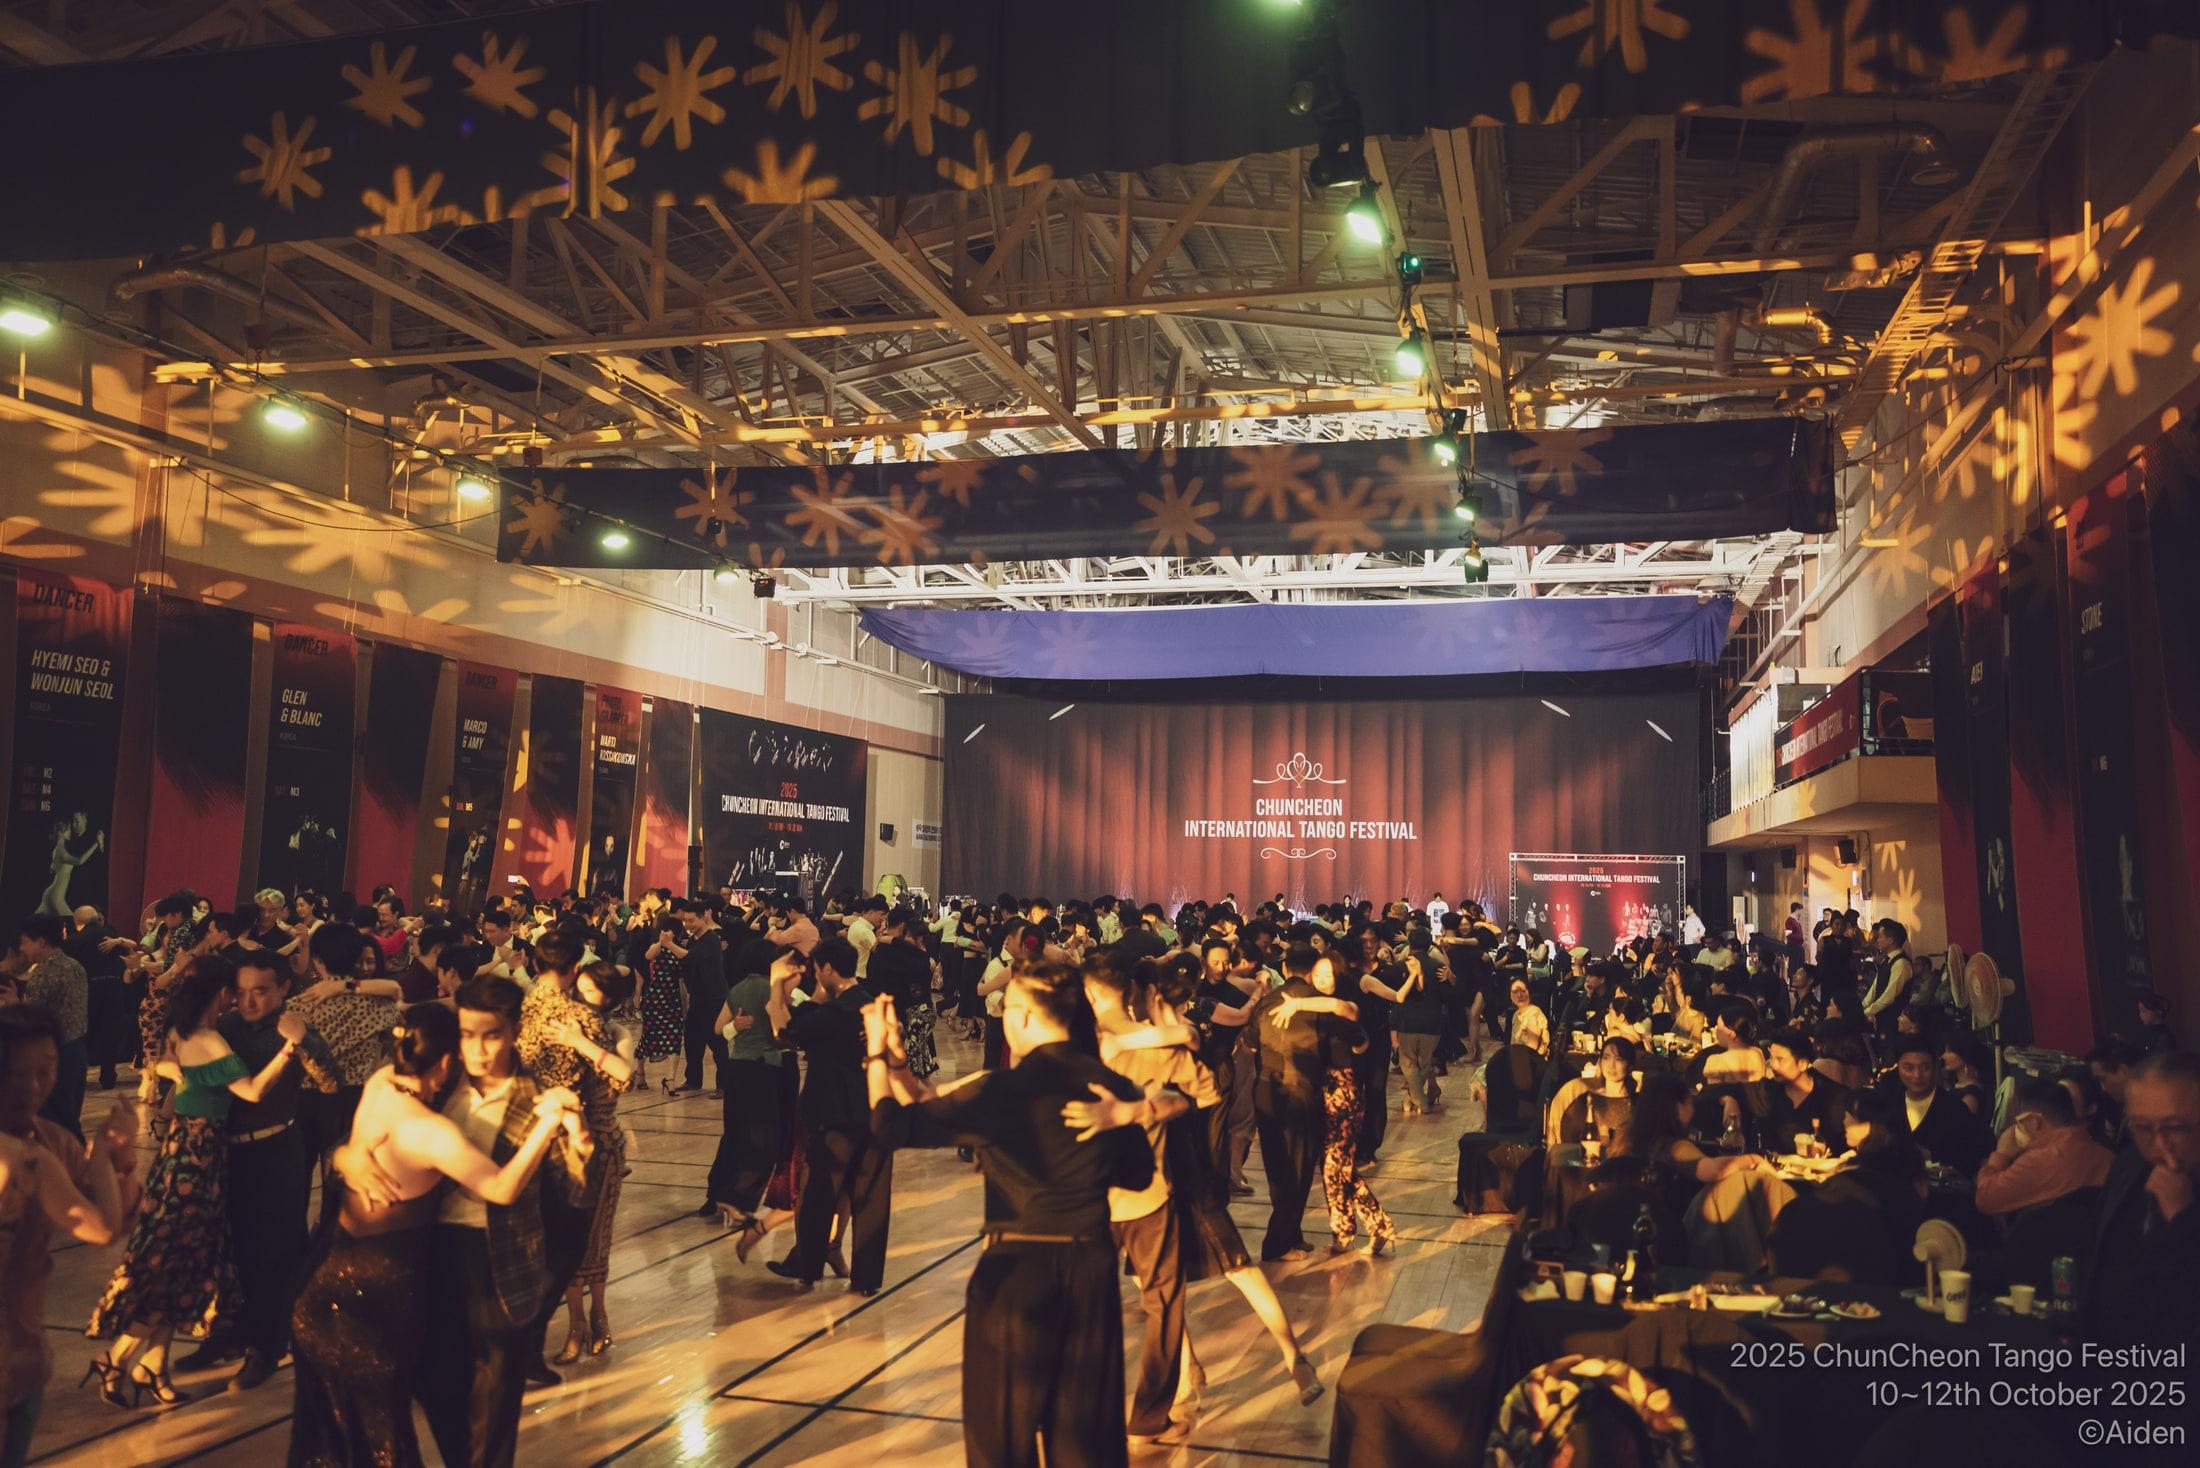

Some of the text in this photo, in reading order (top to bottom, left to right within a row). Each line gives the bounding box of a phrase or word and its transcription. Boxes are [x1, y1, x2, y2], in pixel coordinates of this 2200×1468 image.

[34, 584, 94, 613] DANCER
[31, 649, 111, 677] HYEMI SEO &
[30, 672, 114, 700] WONJUN SEOL
[281, 688, 308, 706] GLEN
[280, 707, 323, 727] & BLANC
[463, 719, 488, 734] MARCO
[467, 736, 485, 750] AMY
[780, 781, 798, 799] 2025
[721, 794, 850, 823] CHUNCHEON INTERNATIONAL TANGO FESTIVAL
[1256, 798, 1343, 816] CHUNCHEON
[1184, 820, 1417, 840] INTERNATIONAL TANGO FESTIVAL
[1533, 873, 1661, 884] CHUNCHEON INTERNATIONAL TANGO FESTIVAL
